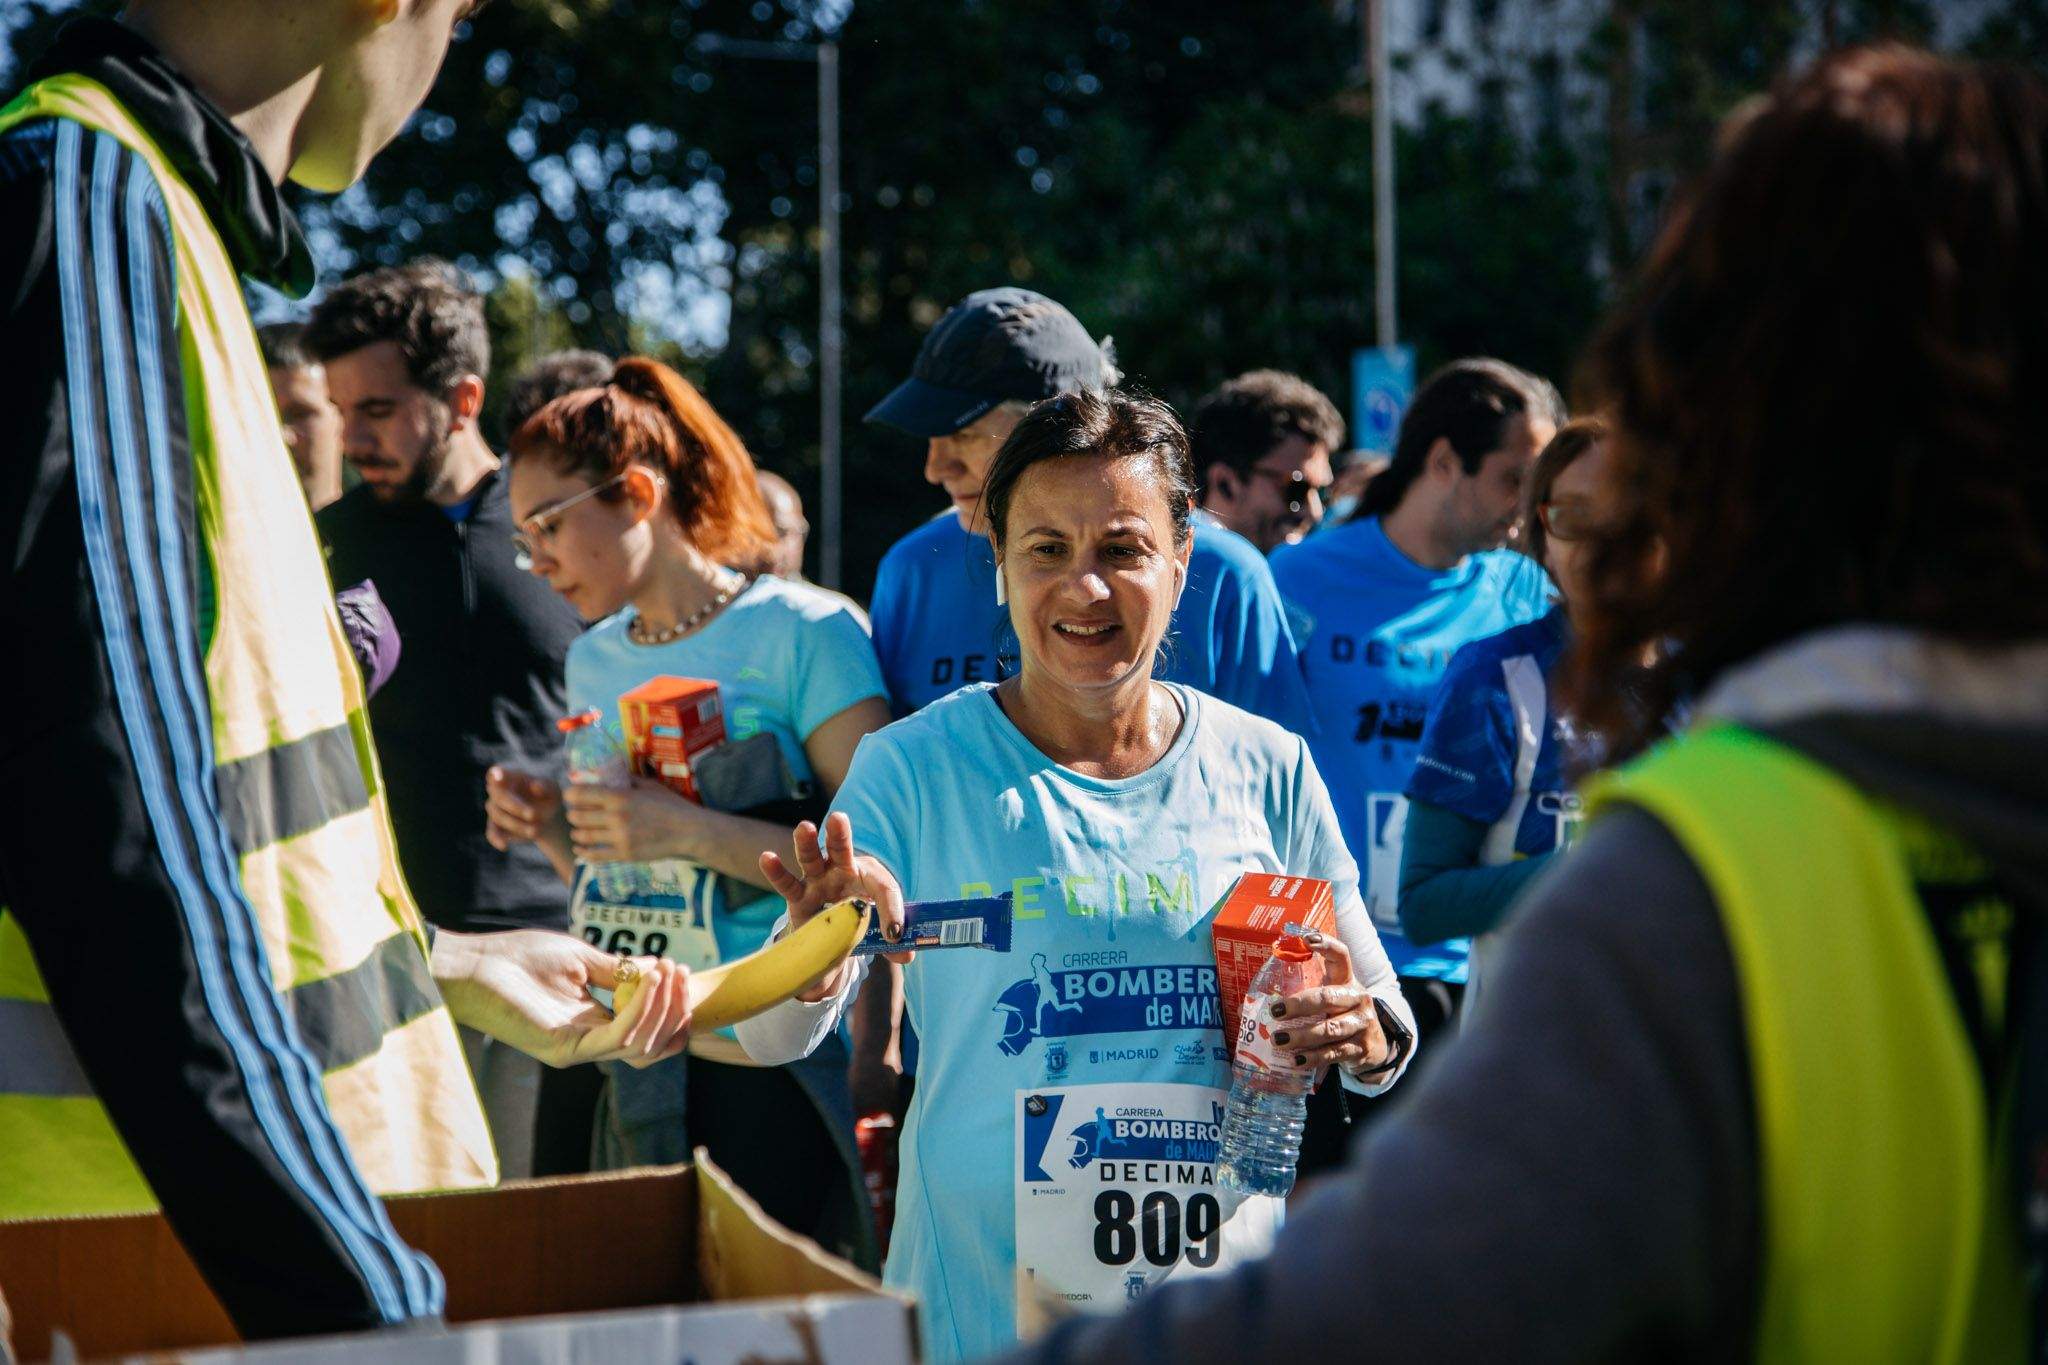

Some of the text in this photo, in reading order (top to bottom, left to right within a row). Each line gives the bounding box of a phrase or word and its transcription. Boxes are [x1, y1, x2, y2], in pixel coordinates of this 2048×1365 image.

[1063, 951, 1128, 968] CARRERA
[1145, 998, 1173, 1027] de
[1106, 1048, 1159, 1061] MADRID
[1115, 1108, 1164, 1118] CARRERA
[1115, 1120, 1221, 1141] BOMBERO
[1165, 1142, 1182, 1160] de
[1100, 1163, 1214, 1185] DECIMA
[1040, 1188, 1066, 1196] MADRID
[1093, 1189, 1221, 1269] 809
